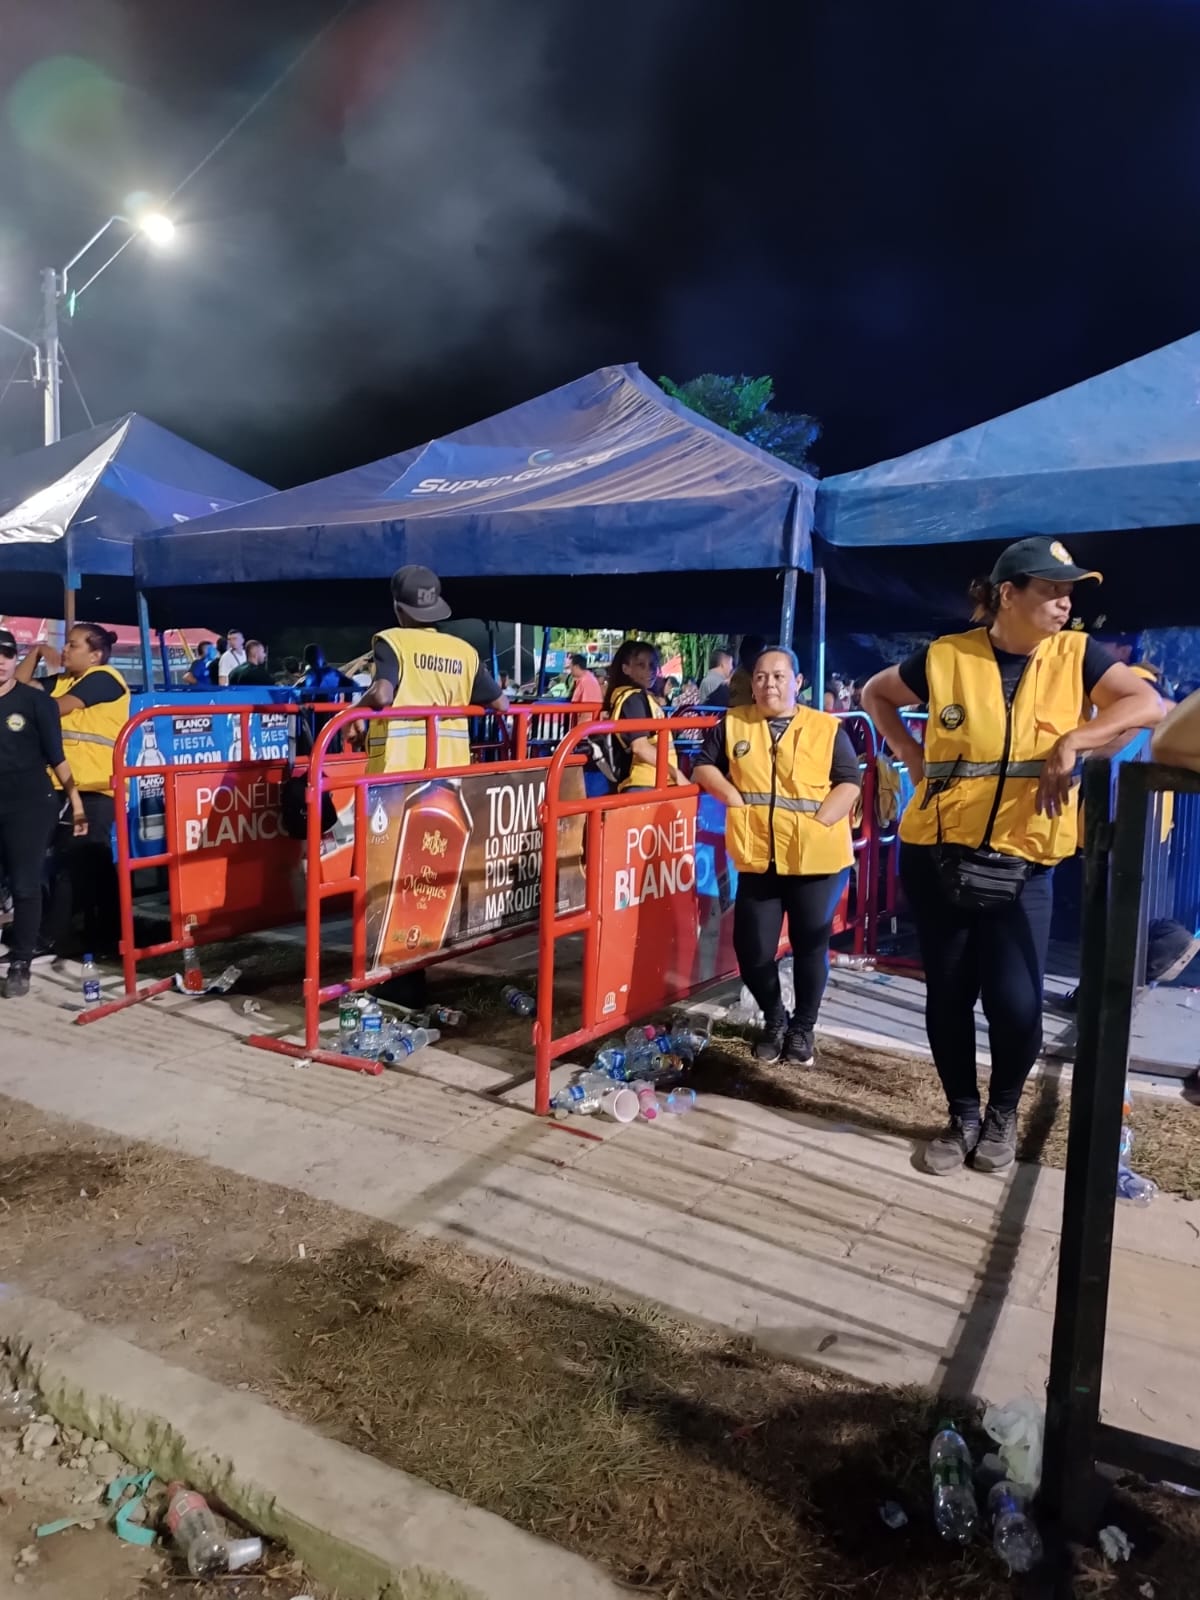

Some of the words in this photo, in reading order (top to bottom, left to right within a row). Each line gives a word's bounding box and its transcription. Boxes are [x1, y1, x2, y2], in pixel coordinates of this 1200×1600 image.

[175, 718, 210, 729] BLANCO
[173, 736, 214, 750] FIESTA
[485, 836, 499, 860] LO
[503, 831, 543, 857] NUESTR
[485, 857, 513, 889] PIDE
[409, 928, 419, 942] 3
